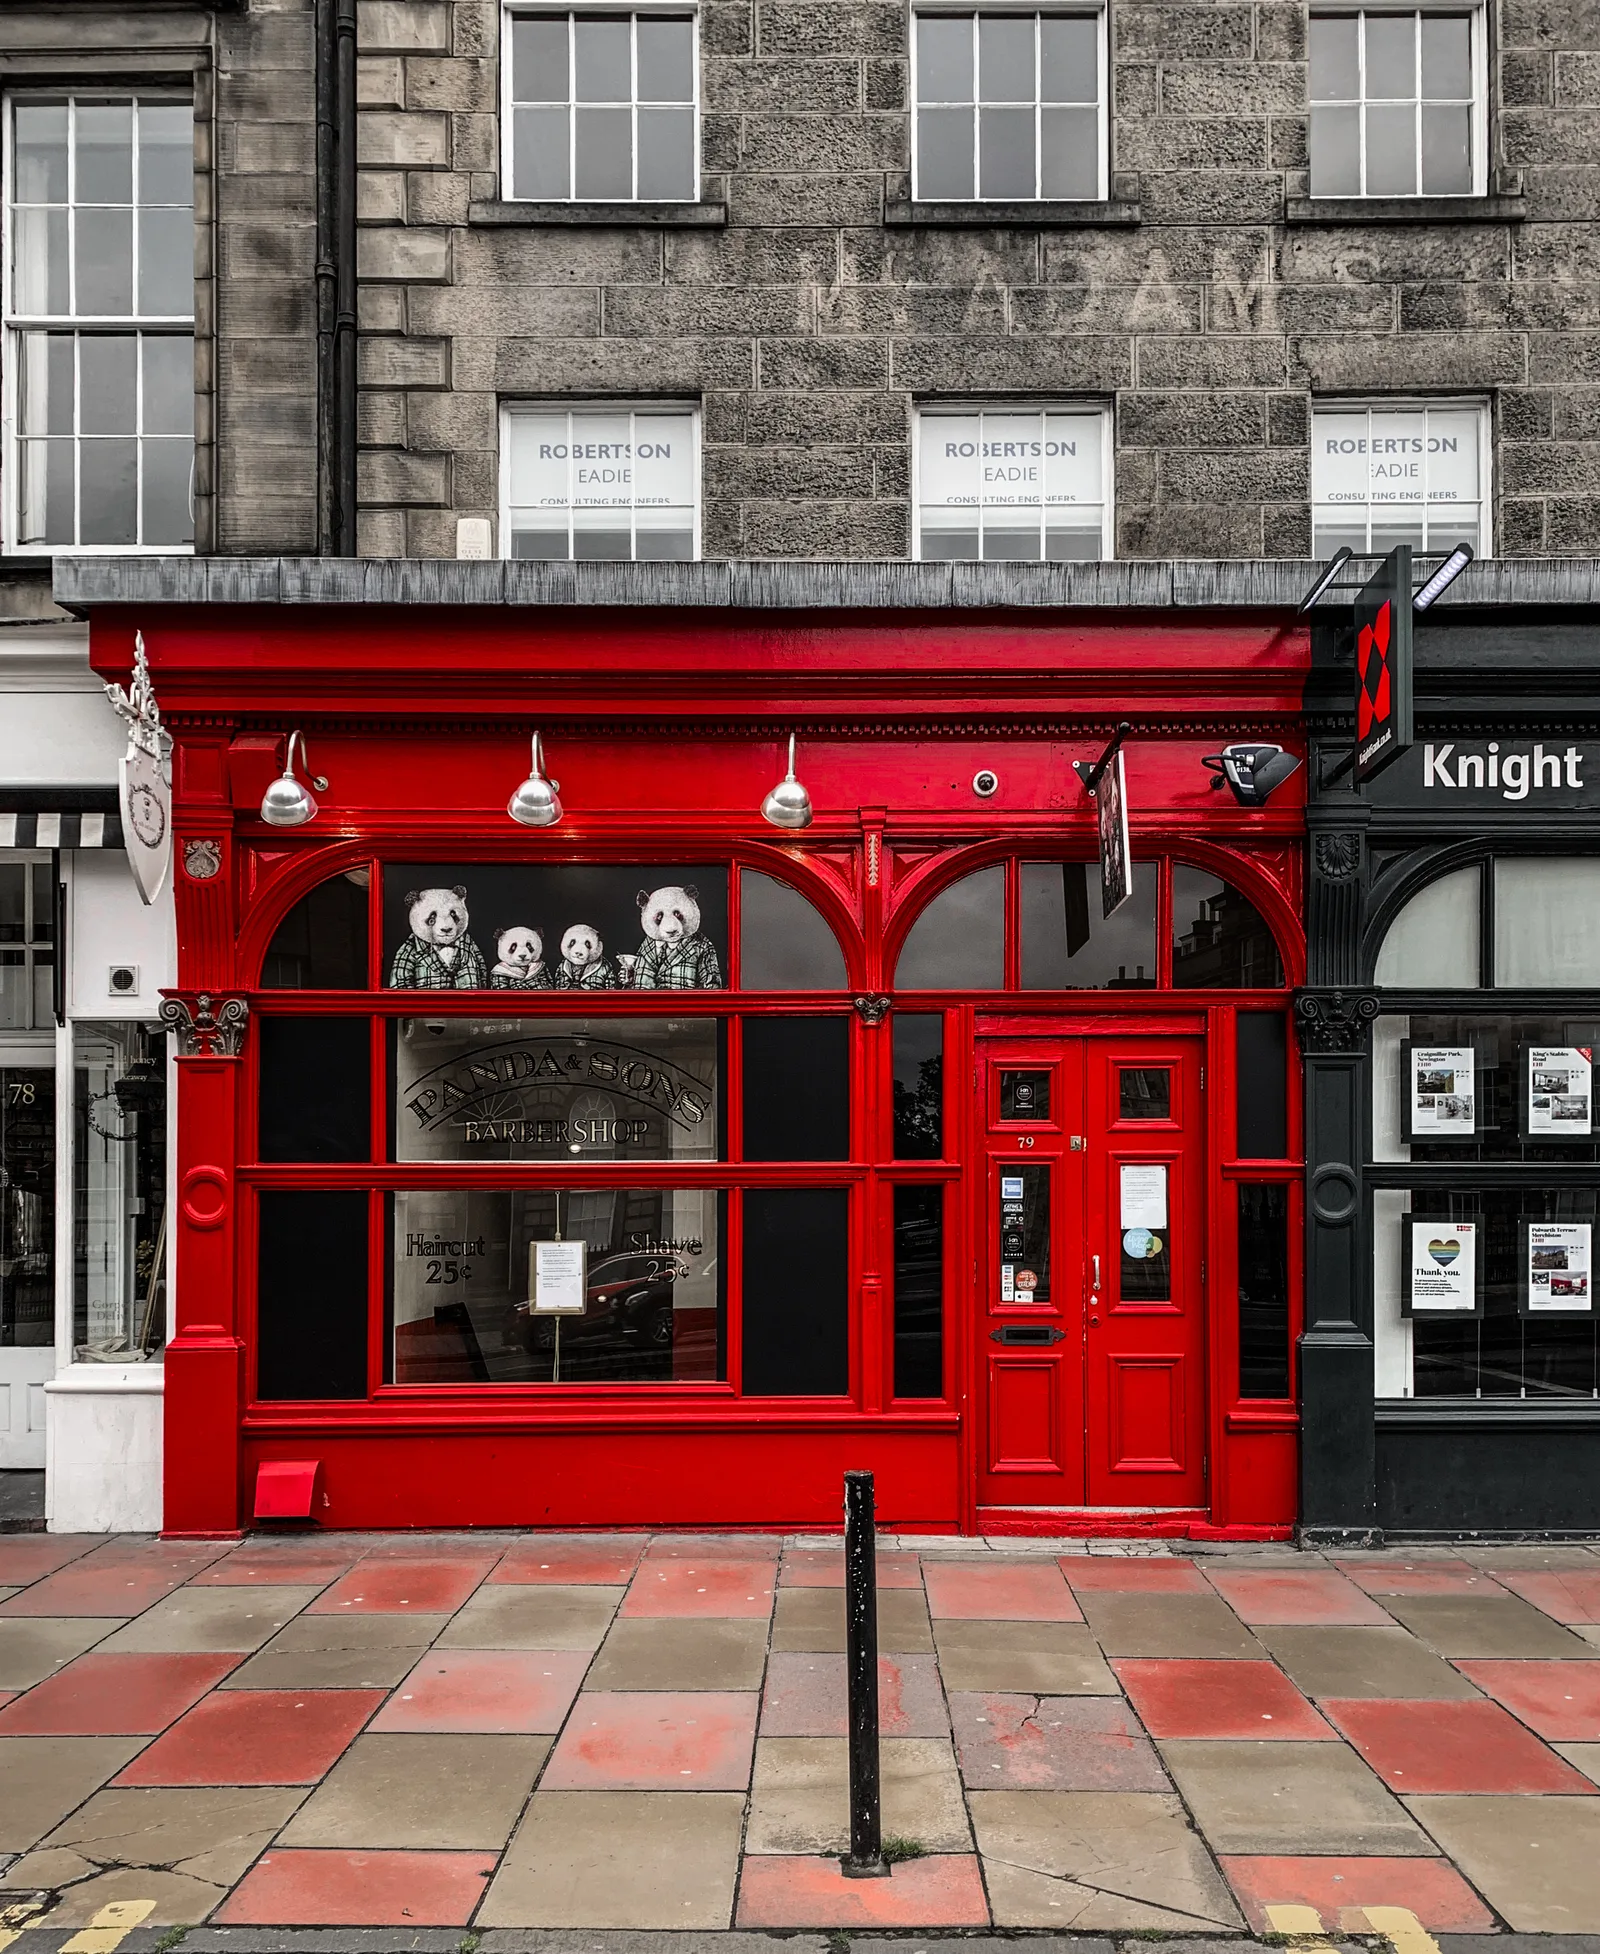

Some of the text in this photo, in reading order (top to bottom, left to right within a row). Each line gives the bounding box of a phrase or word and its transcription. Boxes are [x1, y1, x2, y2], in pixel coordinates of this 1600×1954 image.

[540, 444, 671, 459] ROBERTSON
[945, 442, 1076, 457] ROBERTSON
[1326, 438, 1457, 454] ROBERTSON
[579, 469, 631, 483] EADIE
[984, 467, 1037, 481] EADIE
[946, 495, 1076, 504] CONSLTING ENGNEERS
[1328, 492, 1396, 500] CONSUTING
[1423, 742, 1584, 801] Knight
[9, 1083, 36, 1104] 78
[405, 1049, 711, 1129] PANDA & SONS
[464, 1119, 649, 1145] BARBERSHOP
[1017, 1136, 1034, 1149] 79
[406, 1233, 486, 1257] Haircut
[630, 1232, 703, 1256] Shave
[425, 1260, 473, 1285] 25¢
[646, 1260, 690, 1283] 25¢
[1414, 1268, 1461, 1278] Thank you.
